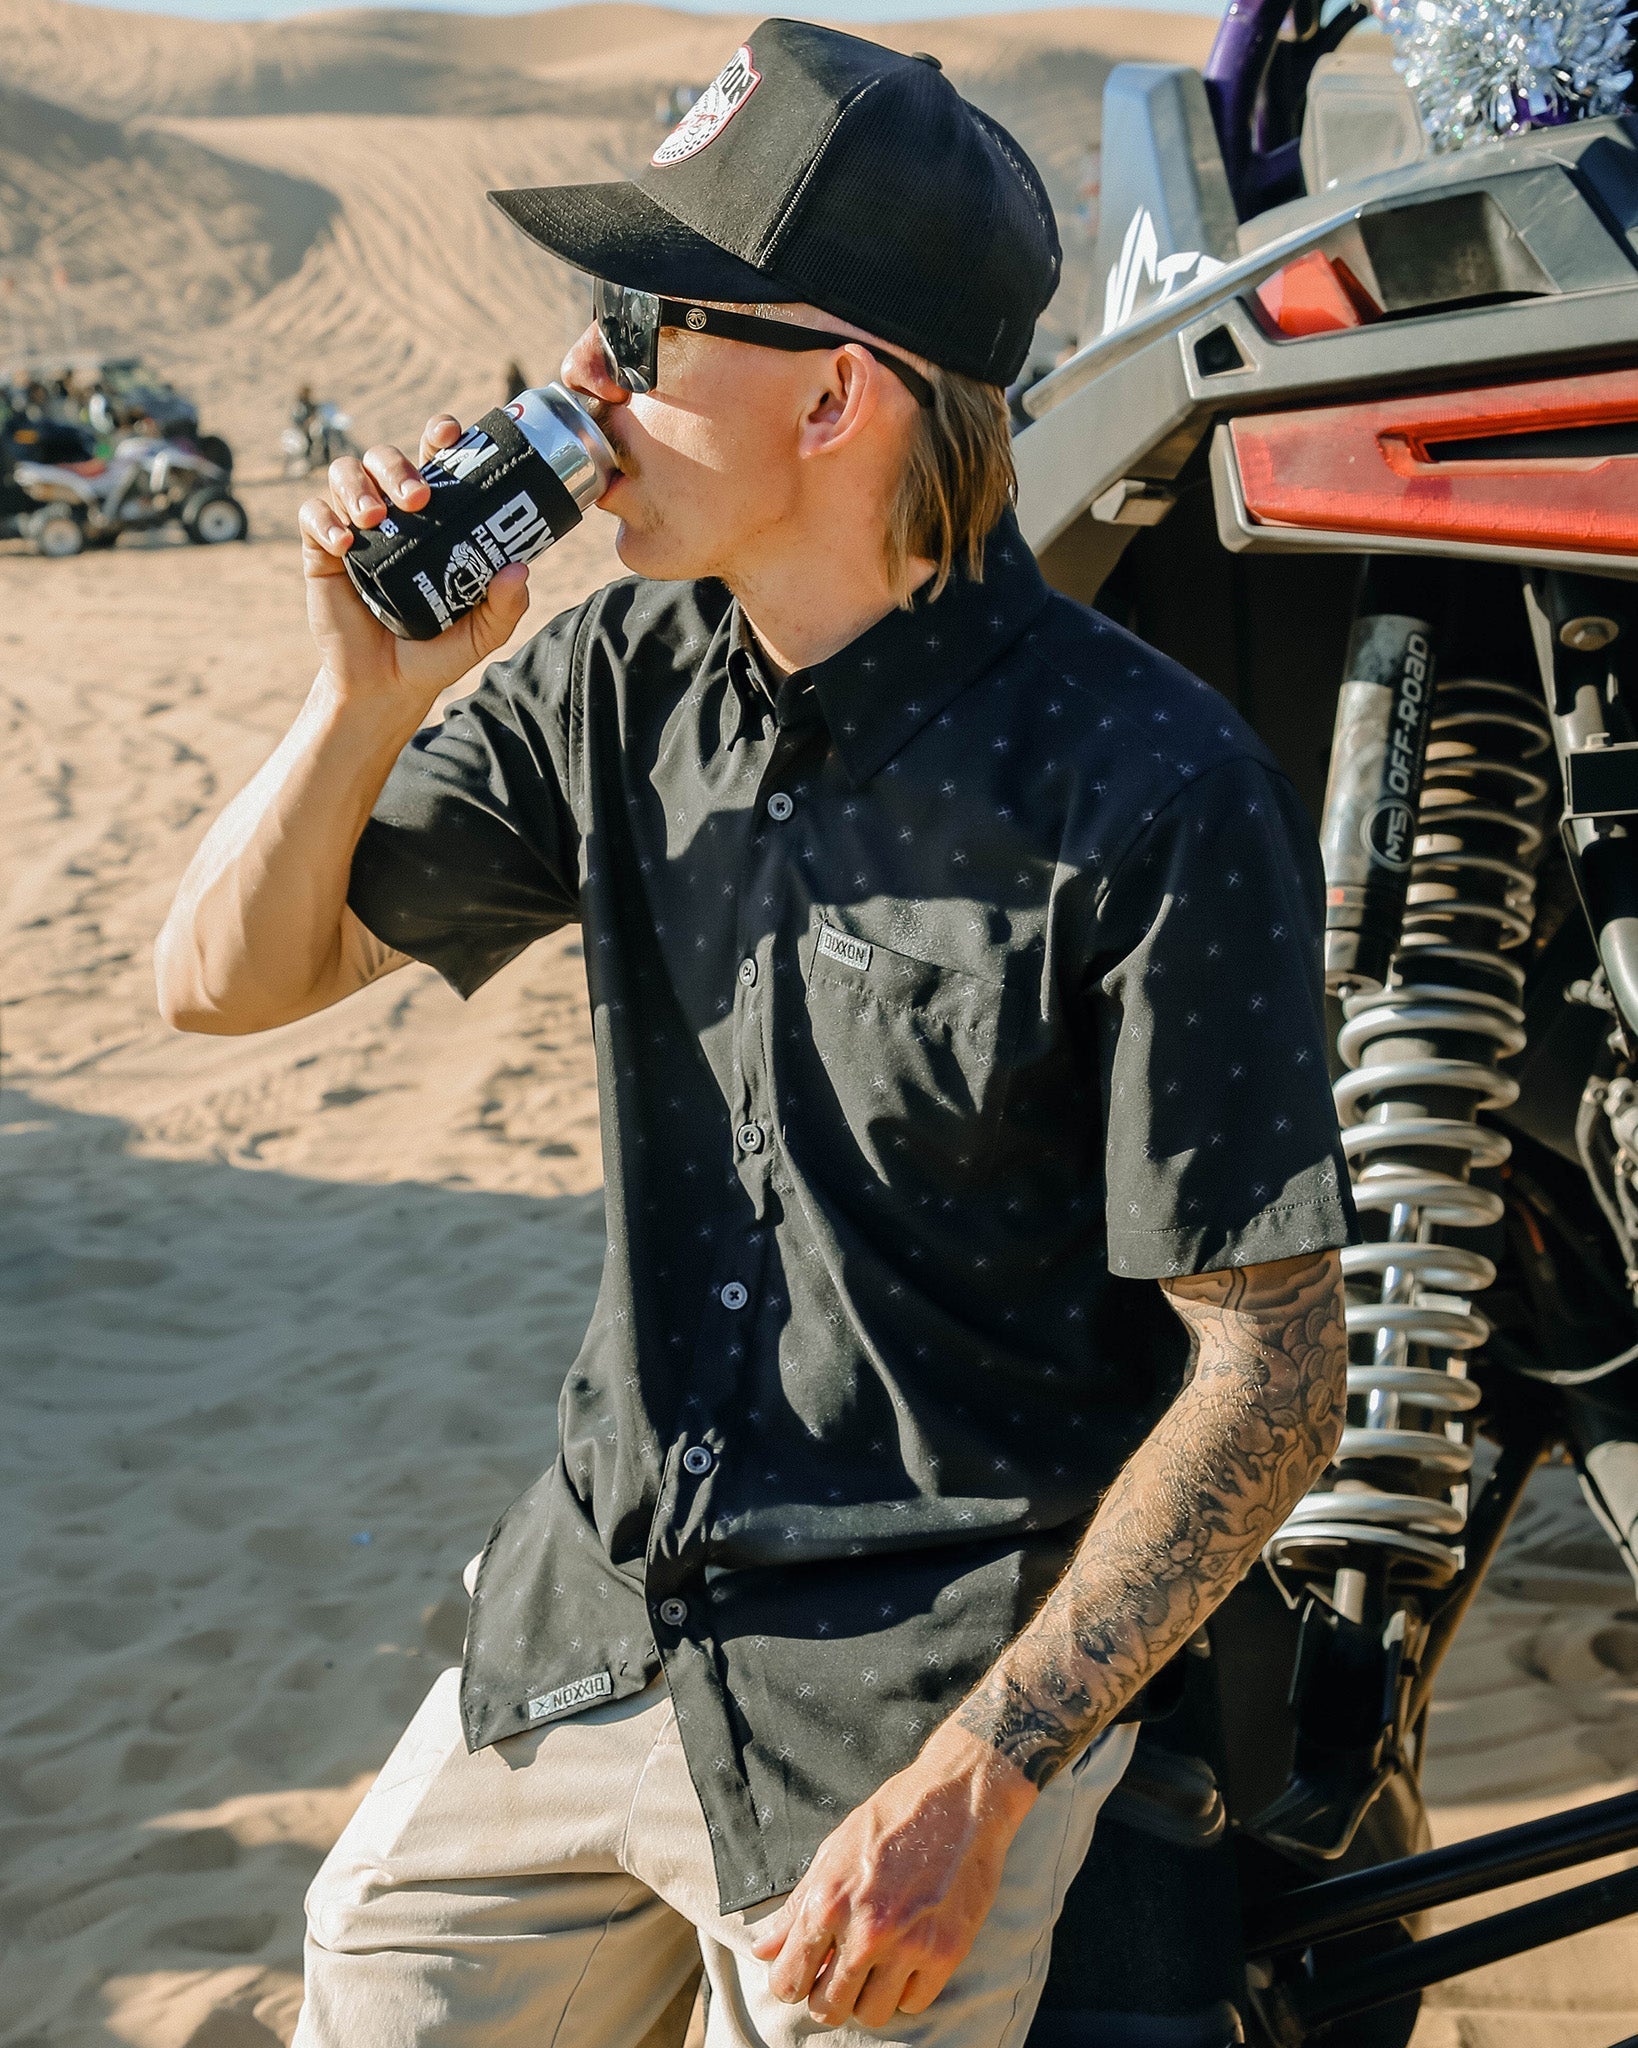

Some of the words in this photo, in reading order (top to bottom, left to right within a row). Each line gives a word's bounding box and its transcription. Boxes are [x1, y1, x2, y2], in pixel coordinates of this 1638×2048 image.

[470, 523, 508, 573] FLANNEL
[1385, 808, 1409, 862] MTS
[824, 933, 866, 964] DIXXON
[552, 1676, 605, 1709] DIXXON
